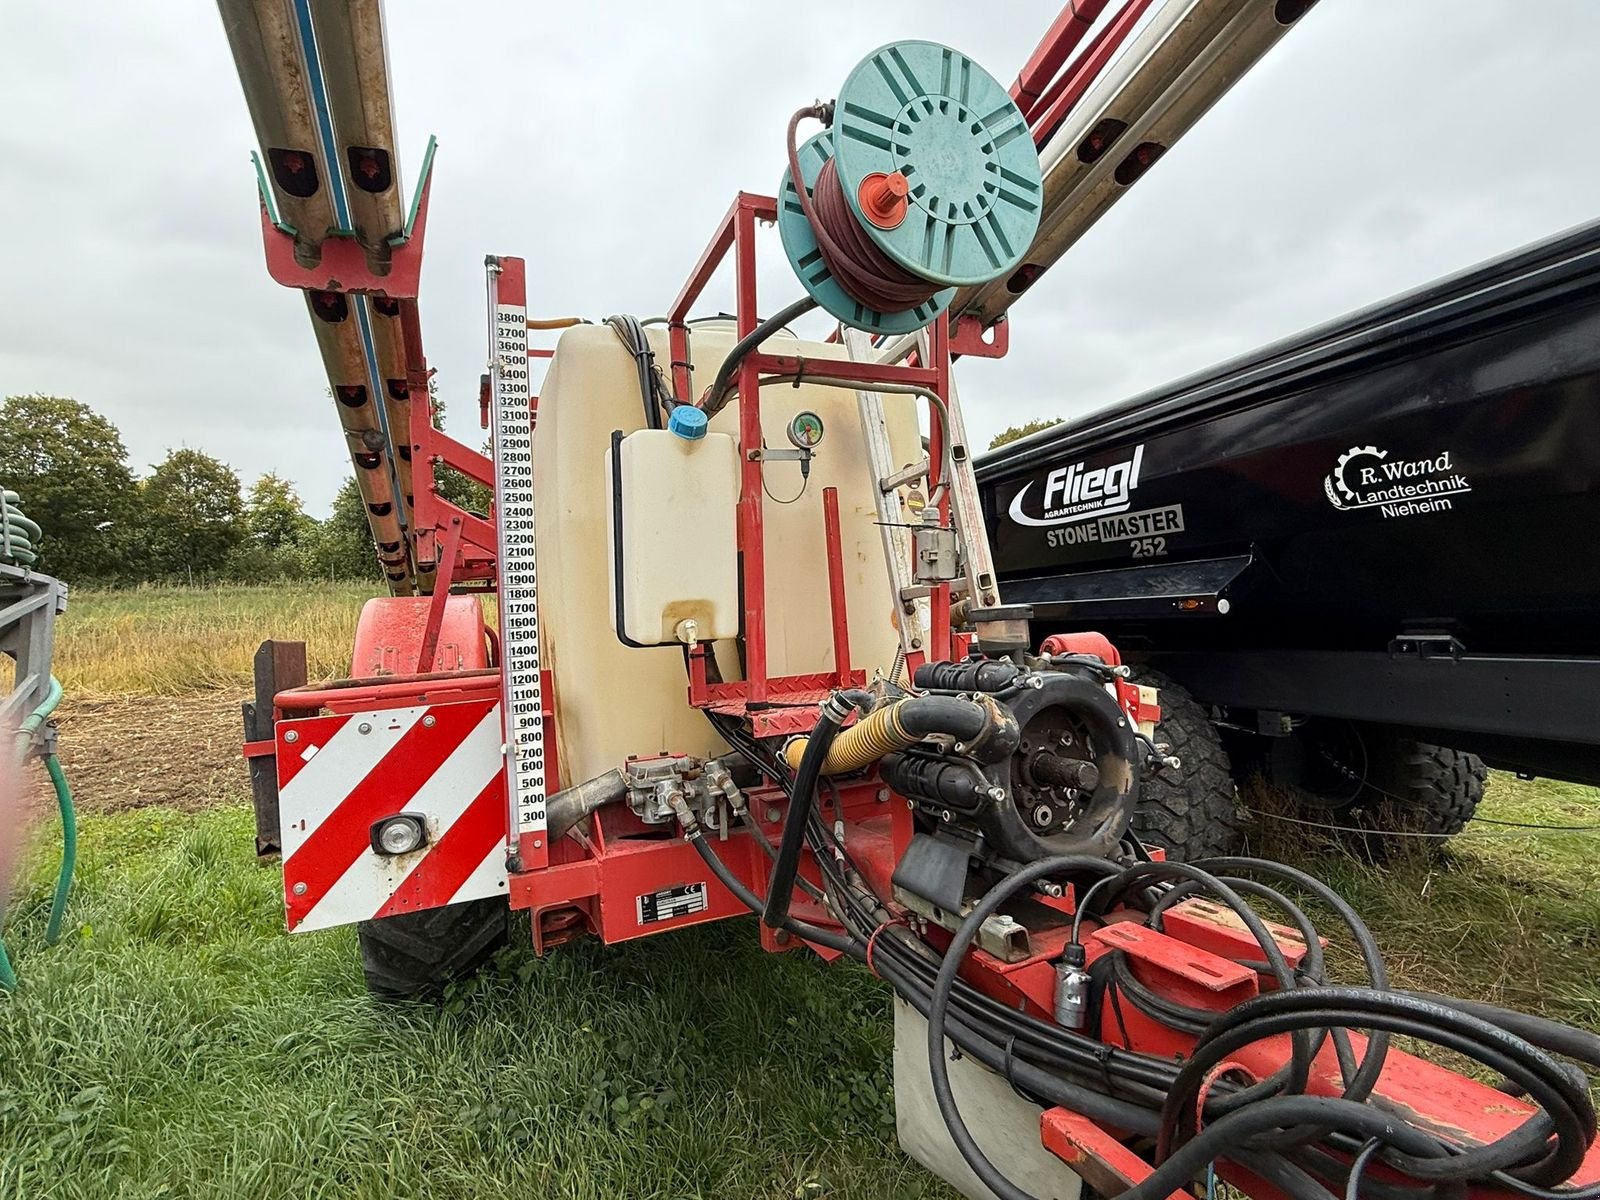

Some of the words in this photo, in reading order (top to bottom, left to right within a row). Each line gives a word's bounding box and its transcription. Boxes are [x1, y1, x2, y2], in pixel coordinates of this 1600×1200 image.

[497, 314, 524, 324] 3800
[498, 328, 525, 339] 3700
[499, 342, 526, 352] 3600
[501, 382, 527, 393] 3300
[501, 396, 528, 407] 3200
[502, 410, 528, 421] 3100
[503, 424, 529, 435] 3000
[503, 438, 530, 449] 2900
[504, 452, 531, 462] 2800
[504, 466, 532, 476] 2700
[1381, 451, 1452, 480] Wand
[1044, 444, 1145, 510] Fliegl
[505, 478, 532, 488] 2600
[1356, 474, 1469, 504] Landtechnik
[505, 492, 532, 502] 2500
[506, 506, 533, 517] 2400
[1044, 500, 1104, 519] AGRARTECHNIK
[1381, 499, 1452, 518] Nieheim
[507, 520, 534, 530] 2300
[1046, 523, 1099, 548] STONE
[1101, 509, 1180, 539] MASTER
[507, 534, 534, 544] 2200
[508, 546, 535, 557] 2100
[1130, 537, 1168, 558] 252
[509, 560, 535, 571] 2000
[509, 574, 536, 584] 1900
[510, 588, 536, 599] 1800
[510, 602, 536, 613] 1700
[510, 616, 536, 627] 1600
[510, 630, 537, 640] 1500
[511, 644, 537, 655] 1400
[511, 660, 538, 669] 1300
[512, 674, 538, 684] 1200
[514, 688, 539, 699] 1100
[513, 702, 540, 712] 1000
[520, 716, 541, 727] 900
[520, 732, 541, 742] 800
[520, 748, 542, 758] 700
[521, 760, 542, 771] 600
[522, 776, 543, 787] 500
[522, 794, 544, 804] 400
[523, 810, 545, 821] 300
